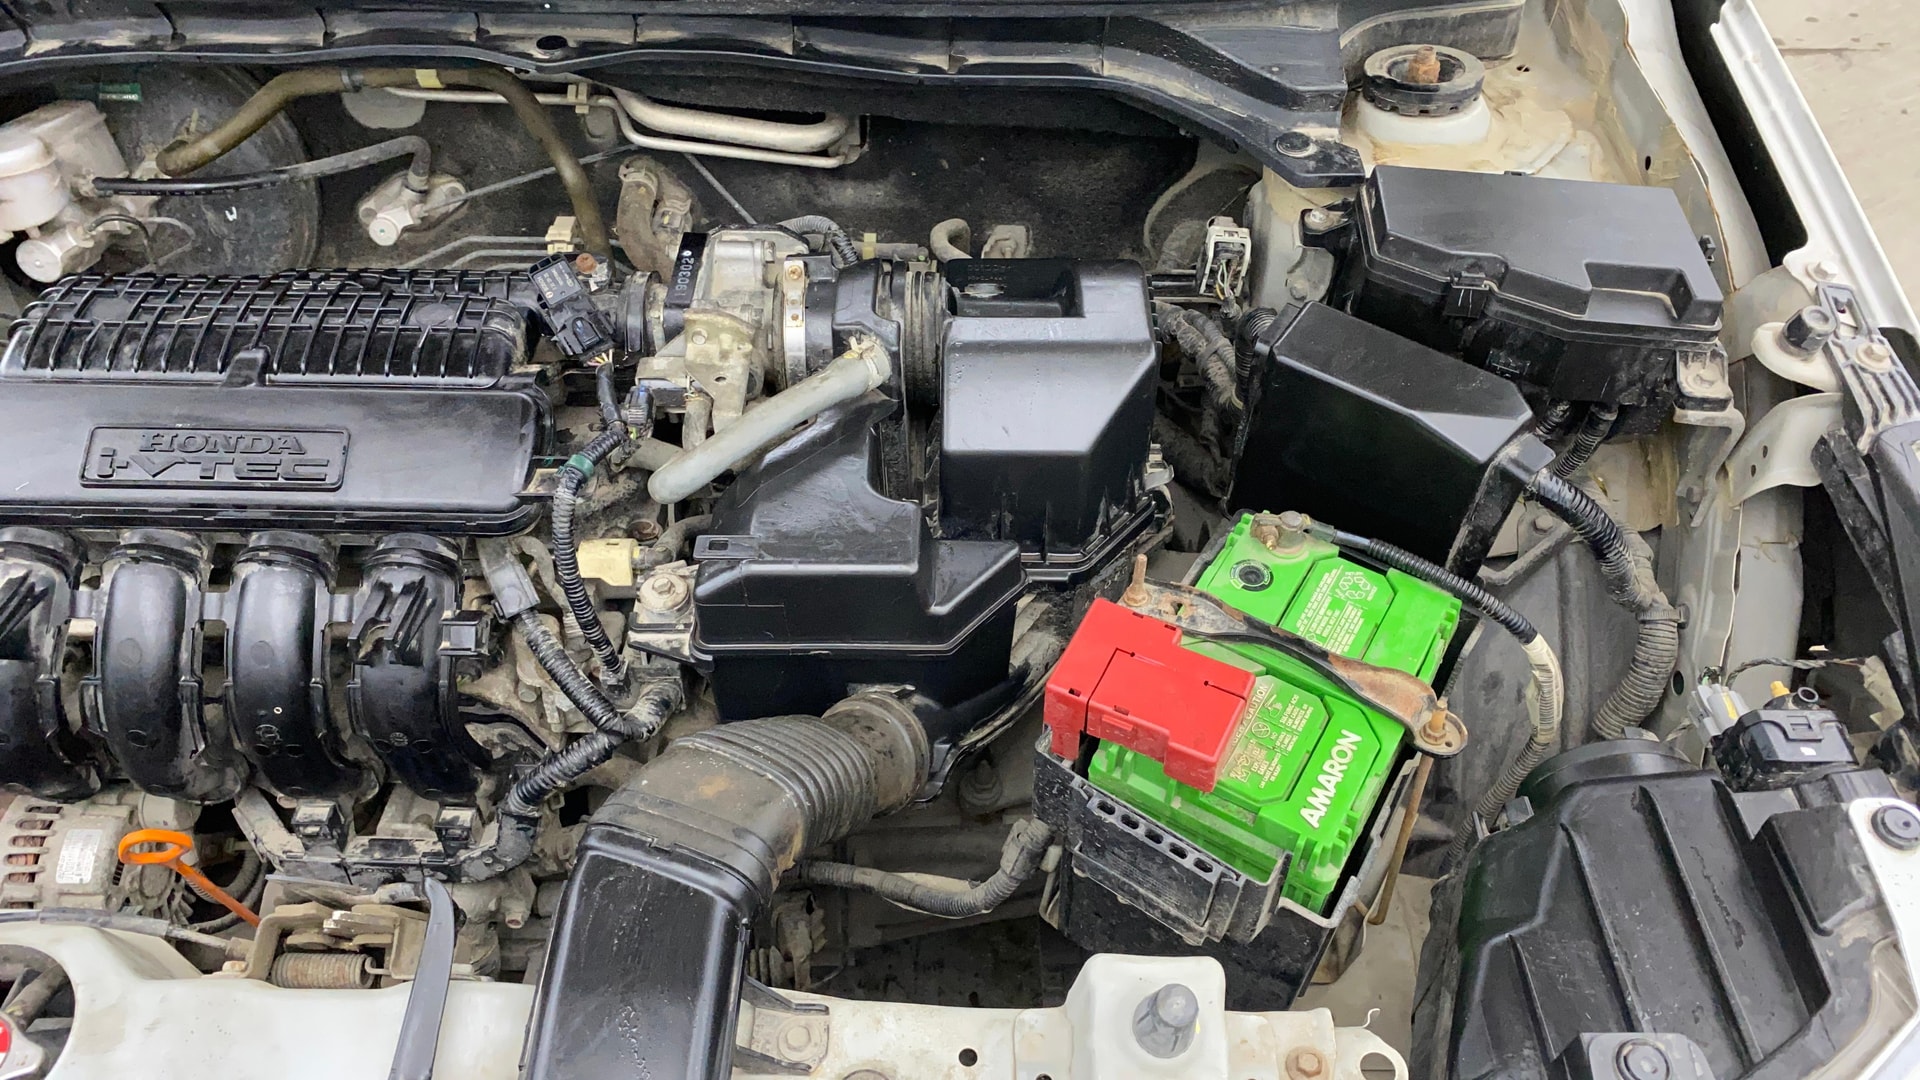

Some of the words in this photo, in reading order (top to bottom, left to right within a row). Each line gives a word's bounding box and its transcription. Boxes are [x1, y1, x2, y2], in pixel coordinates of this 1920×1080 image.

[138, 432, 306, 455] HONDA
[97, 446, 330, 481] i-VTEC
[1242, 682, 1268, 720] CAUTION
[1300, 729, 1363, 829] AMARON
